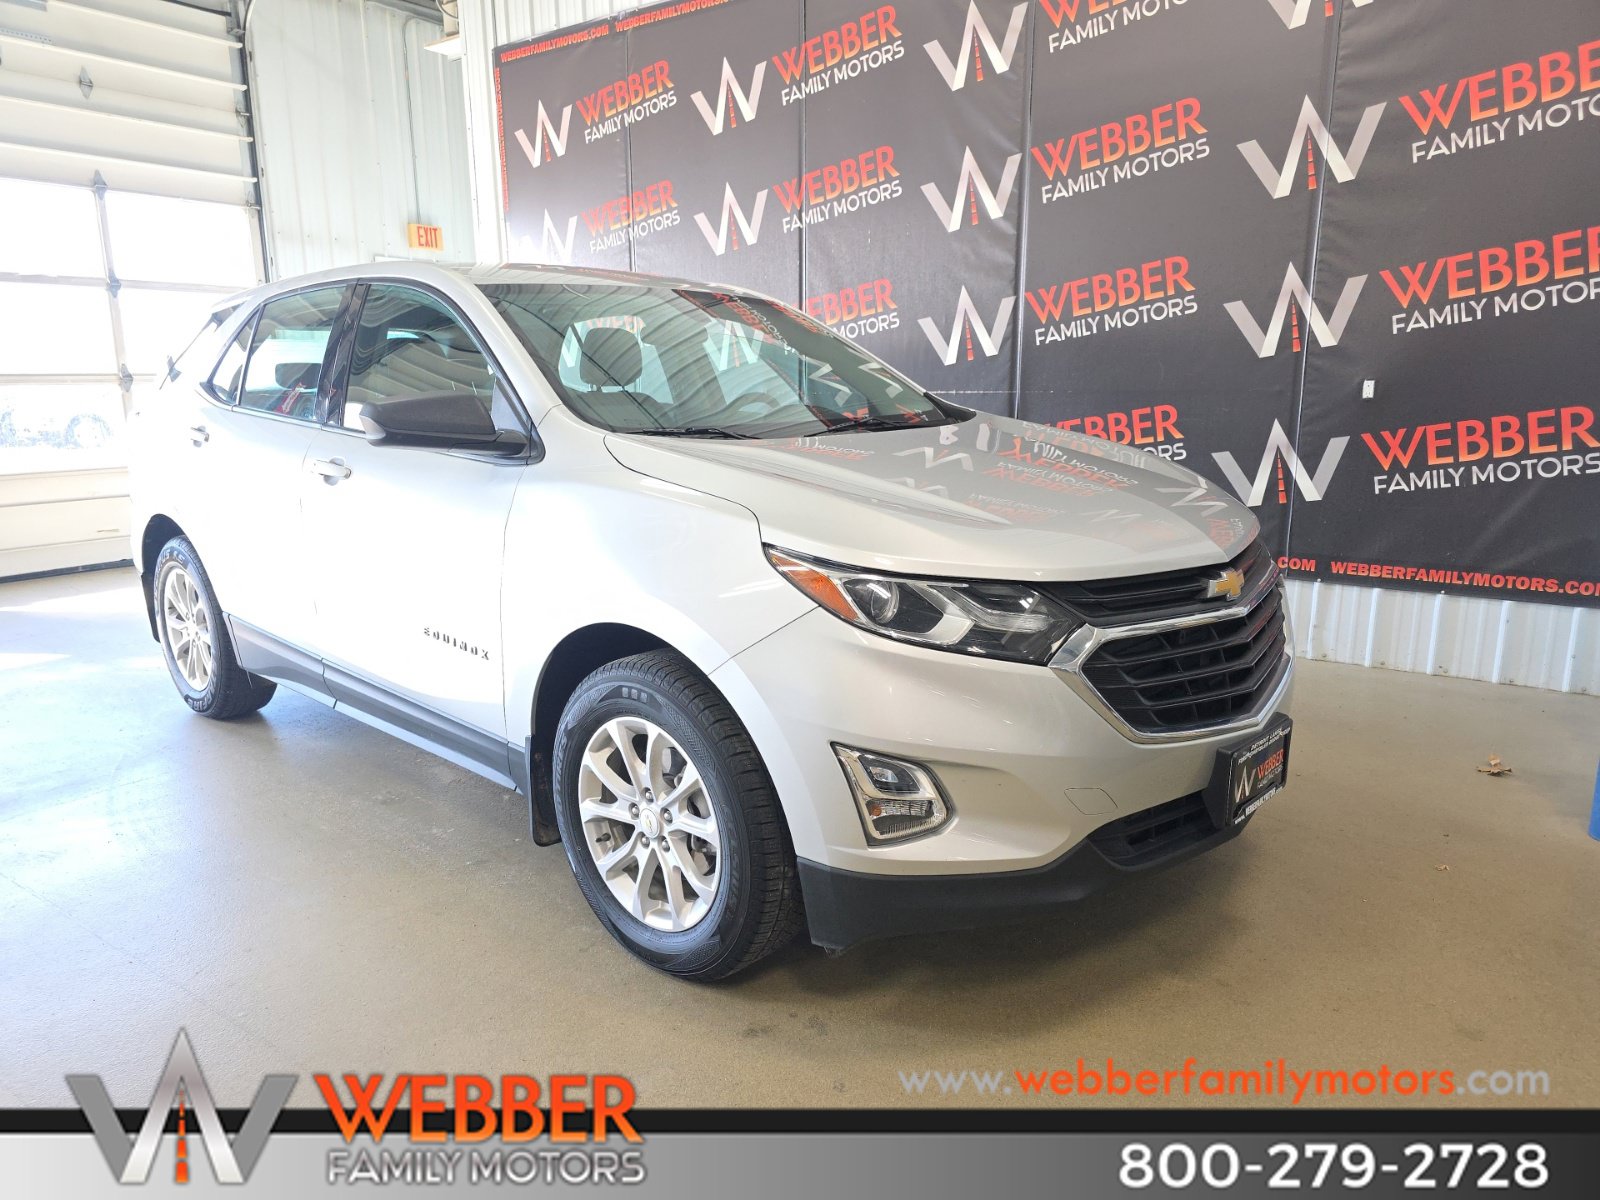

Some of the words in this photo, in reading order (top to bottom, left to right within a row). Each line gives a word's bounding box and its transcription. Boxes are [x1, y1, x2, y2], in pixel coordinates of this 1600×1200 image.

[501, 24, 609, 63] WEBBERFAMILYMOTORS.COM
[772, 5, 902, 85] WEBBER
[1048, 10, 1118, 53] FAMILY
[576, 60, 674, 127] WEBBER
[781, 71, 830, 106] FAMILY
[833, 40, 905, 84] MOTORS
[584, 117, 623, 144] FAMILY
[624, 91, 677, 127] MOTORS
[1031, 97, 1208, 181] WEBBER
[1411, 117, 1511, 164] FAMILY
[773, 146, 900, 214] WEBBER
[1041, 169, 1109, 204] FAMILY
[1113, 138, 1210, 183] MOTORS
[580, 180, 678, 237] WEBBER
[590, 232, 628, 254] FAMILY
[628, 210, 681, 239] MOTORS
[782, 202, 830, 234] FAMILY
[833, 180, 902, 217] MOTORS
[417, 226, 438, 248] EXIT
[791, 278, 898, 325] EBBER
[1024, 256, 1195, 325] WEBBER
[1391, 296, 1487, 335] FAMILY
[1035, 316, 1099, 345] FAMILY
[1104, 295, 1198, 332] MOTORS
[1361, 406, 1600, 471] WEBBER
[1373, 466, 1465, 495] FAMILY
[1472, 452, 1600, 485] MOTORS
[424, 627, 489, 660] EQUINOX
